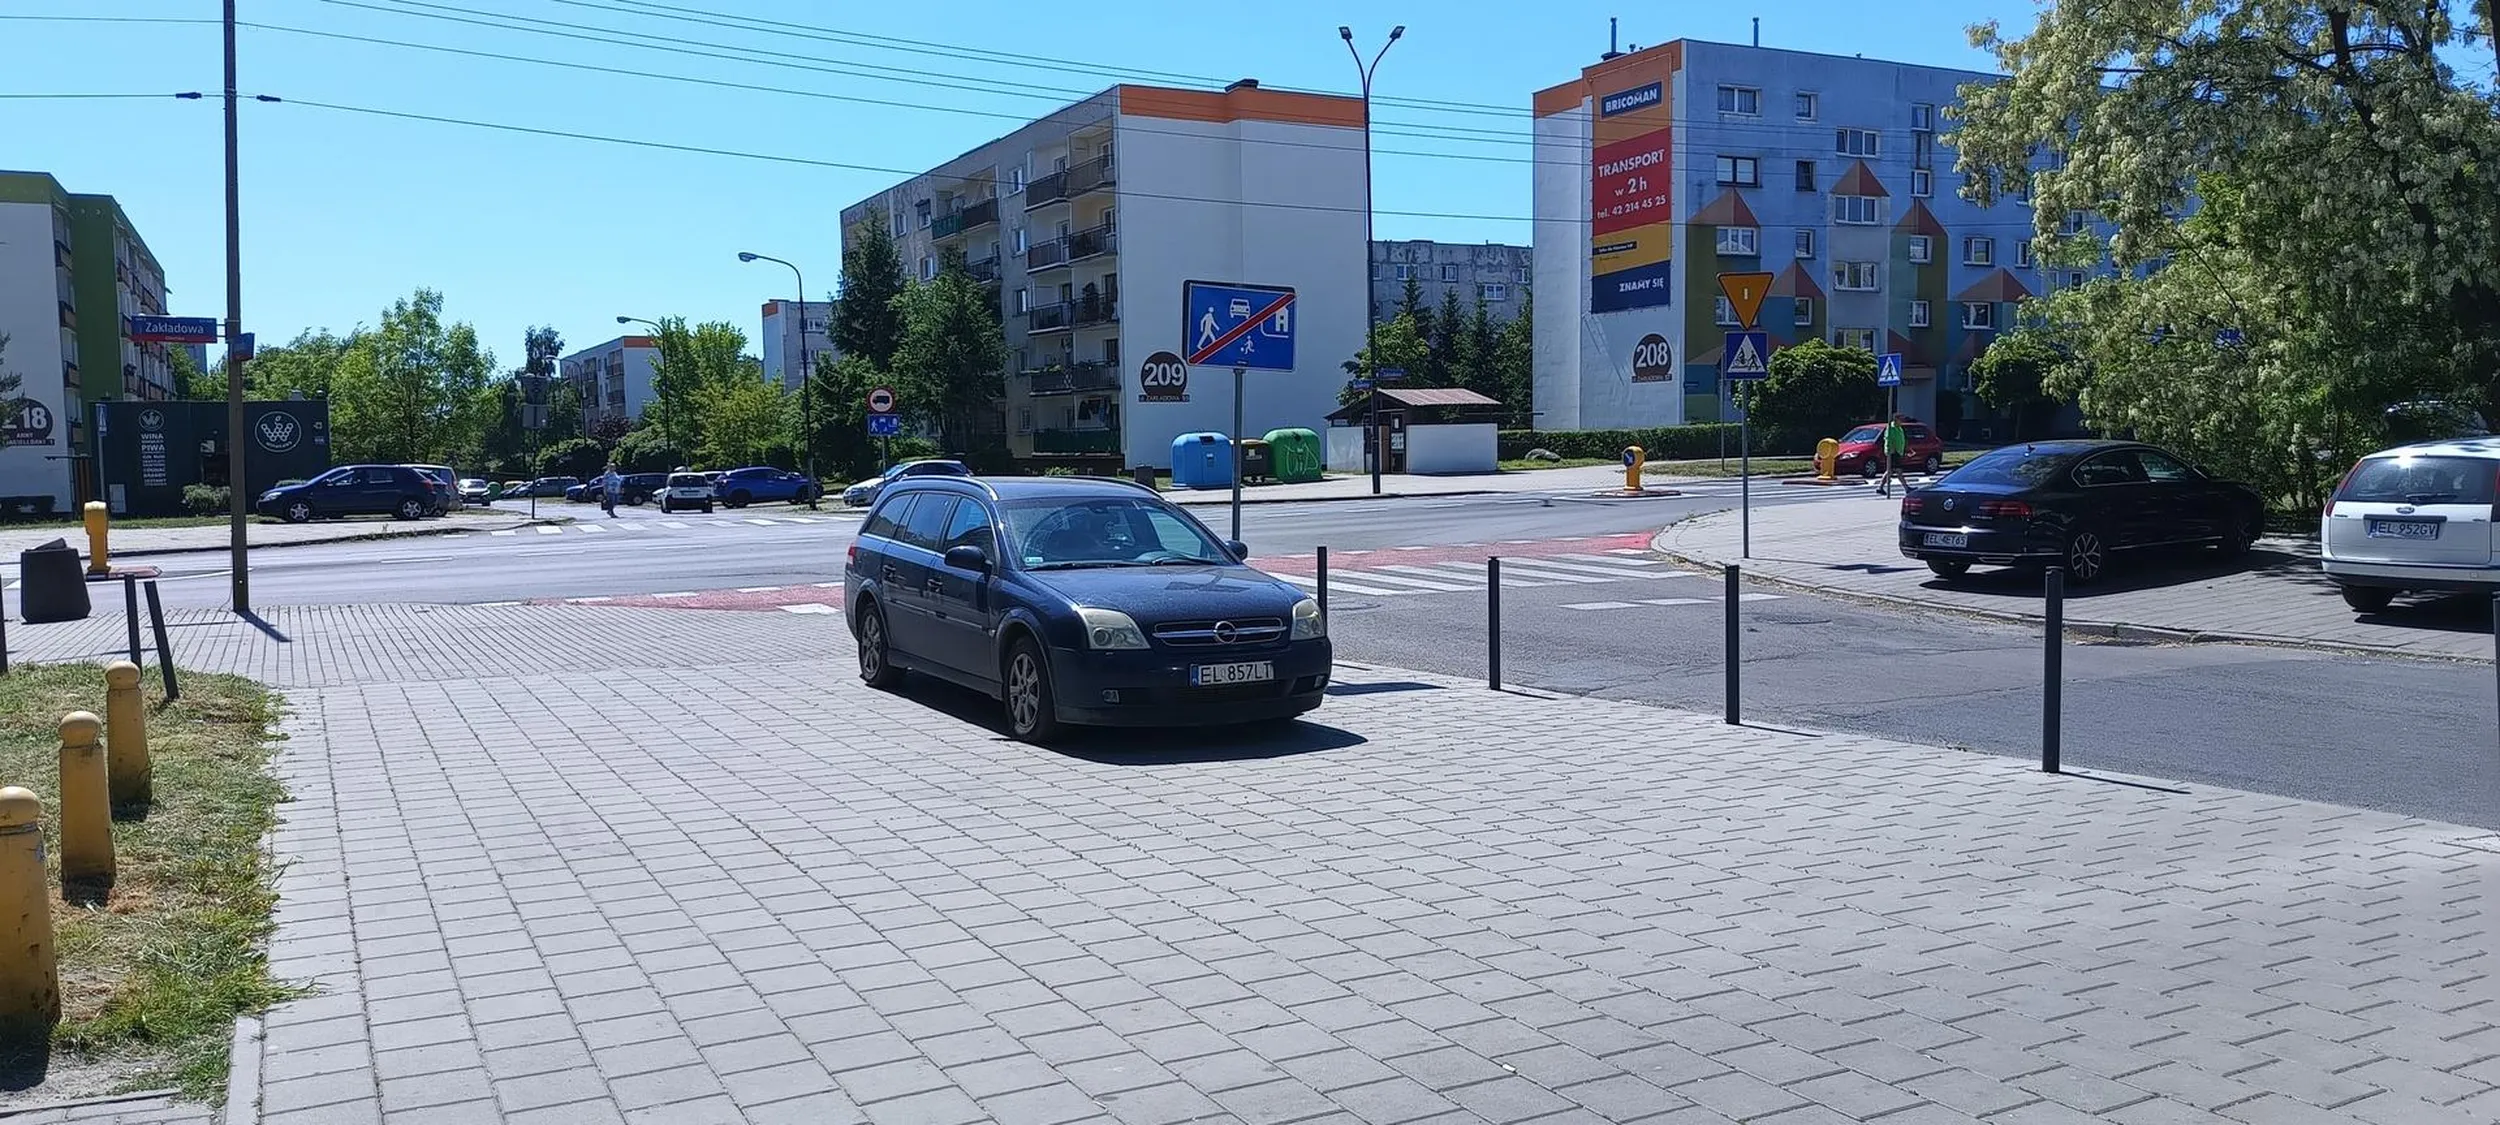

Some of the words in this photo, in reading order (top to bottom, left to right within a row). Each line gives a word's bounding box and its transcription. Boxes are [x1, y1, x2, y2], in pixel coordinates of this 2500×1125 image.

[1605, 88, 1657, 112] BRICOMAN
[1599, 149, 1665, 178] TRANSPORT
[1614, 188, 1624, 197] w
[1628, 178, 1637, 194] 2
[1639, 177, 1647, 191] h
[1597, 208, 1610, 219] tel.
[1612, 204, 1622, 215] 42
[1625, 201, 1639, 213] 214
[1642, 197, 1653, 209] 45
[1655, 195, 1666, 206] 25
[1619, 280, 1650, 292] ZNAMY
[1652, 277, 1664, 289] SIĘ
[1636, 342, 1668, 368] 208
[1144, 363, 1185, 386] 209
[2378, 522, 2395, 533] EL
[2399, 522, 2436, 535] 952GV
[1201, 667, 1222, 683] EL
[1228, 663, 1271, 681] 857LT
